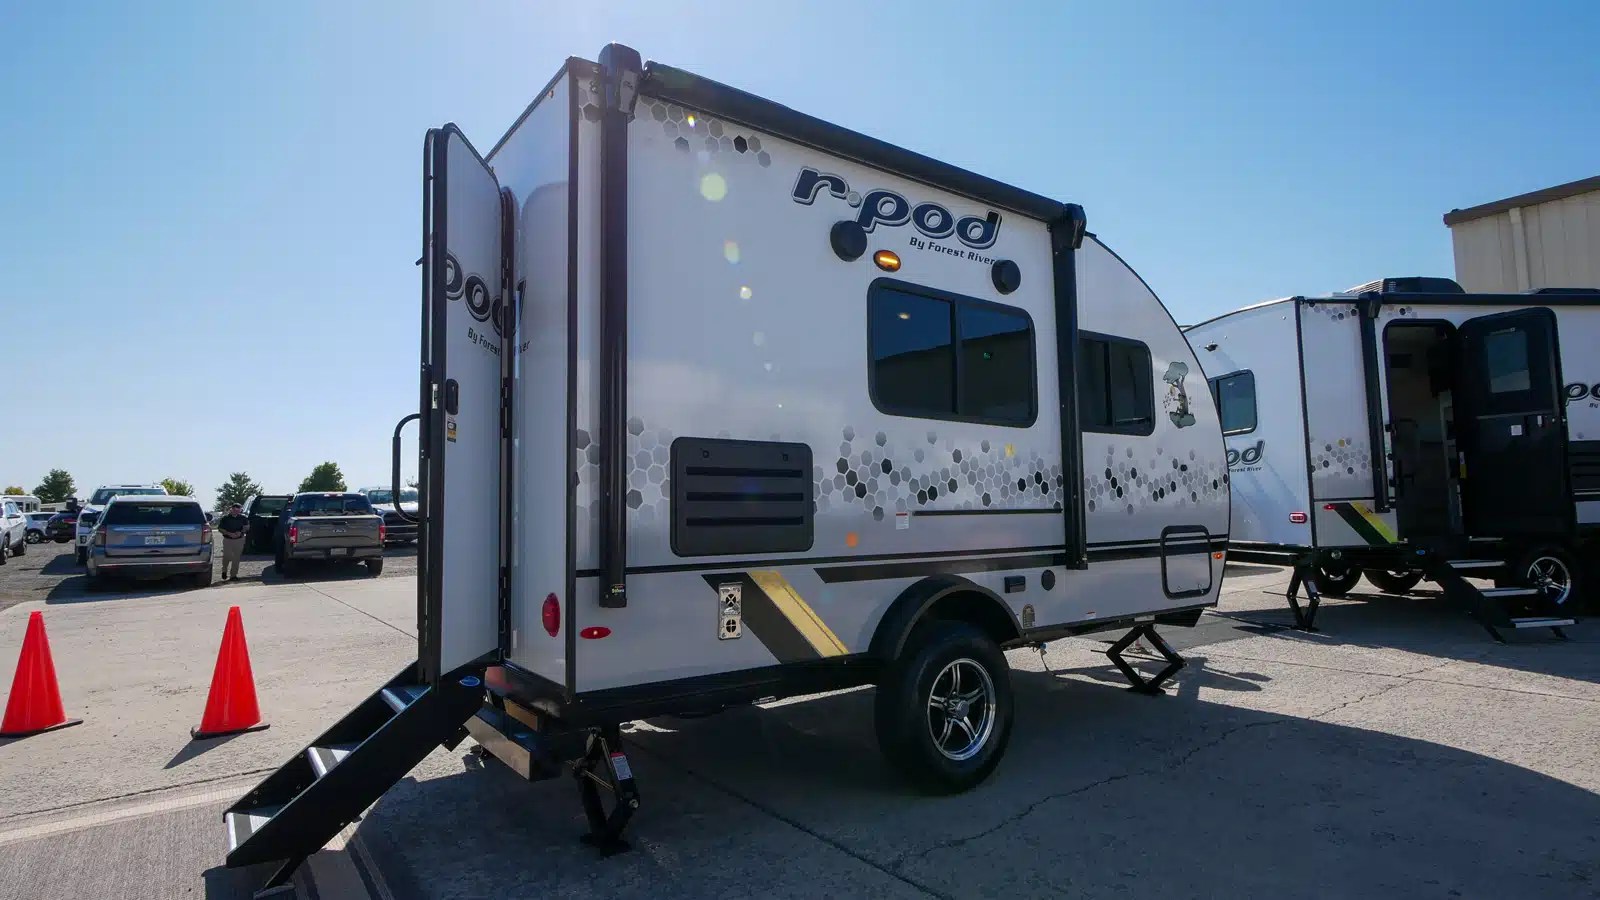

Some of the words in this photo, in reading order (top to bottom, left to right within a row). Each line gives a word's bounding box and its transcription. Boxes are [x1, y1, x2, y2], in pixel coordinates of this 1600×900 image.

[909, 236, 925, 250] By
[928, 241, 965, 259] Forest
[967, 251, 996, 265] River
[467, 327, 478, 344] By
